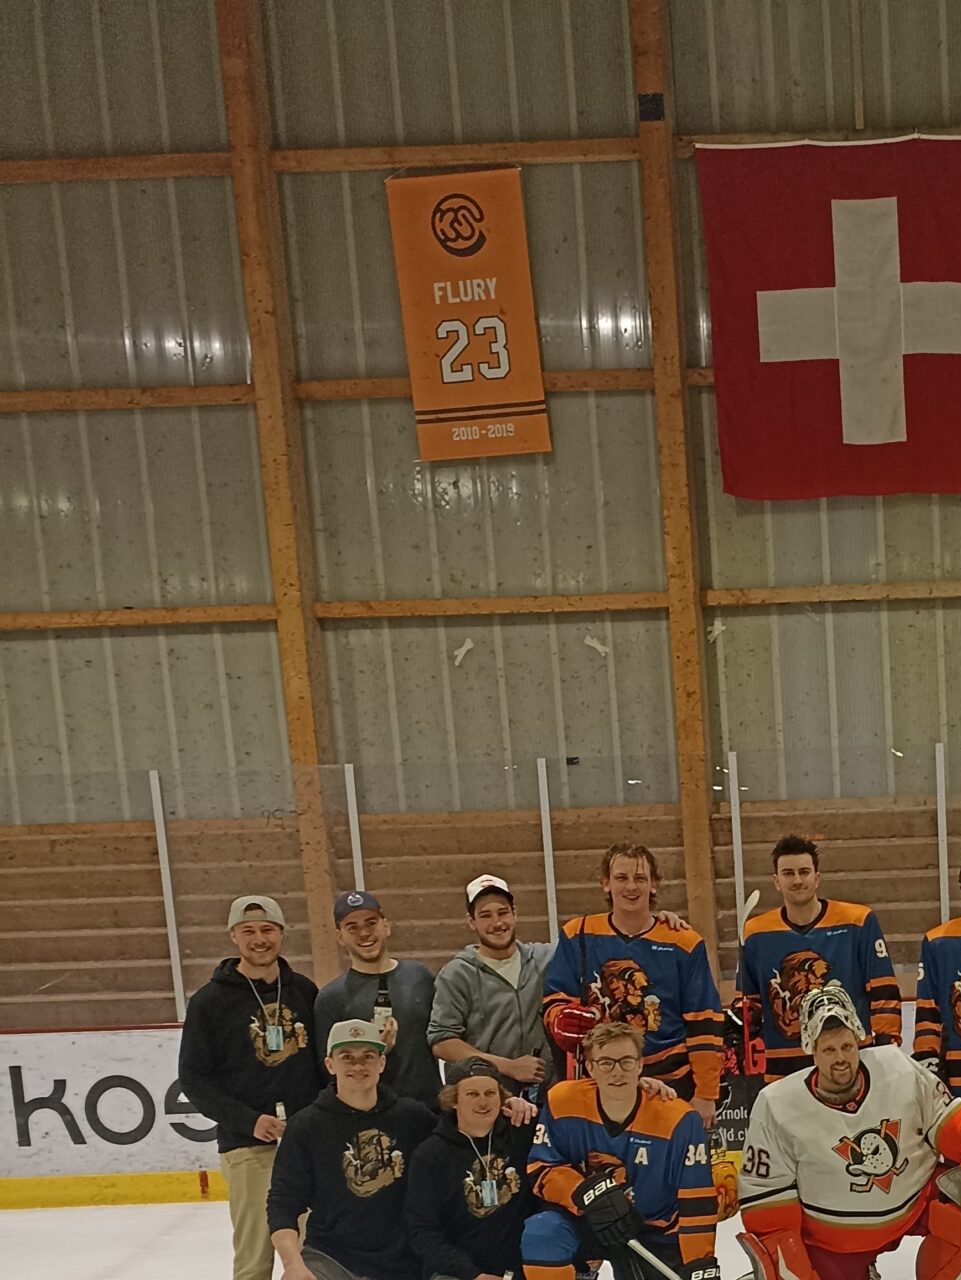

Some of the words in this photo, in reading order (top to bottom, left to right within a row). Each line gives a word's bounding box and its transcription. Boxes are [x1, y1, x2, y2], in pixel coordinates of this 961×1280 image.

[433, 276, 497, 305] FLURY
[435, 315, 511, 384] 23
[452, 423, 515, 442] 2010-2019
[634, 1146, 648, 1165] A
[685, 1143, 707, 1166] 34
[743, 1145, 770, 1177] 36
